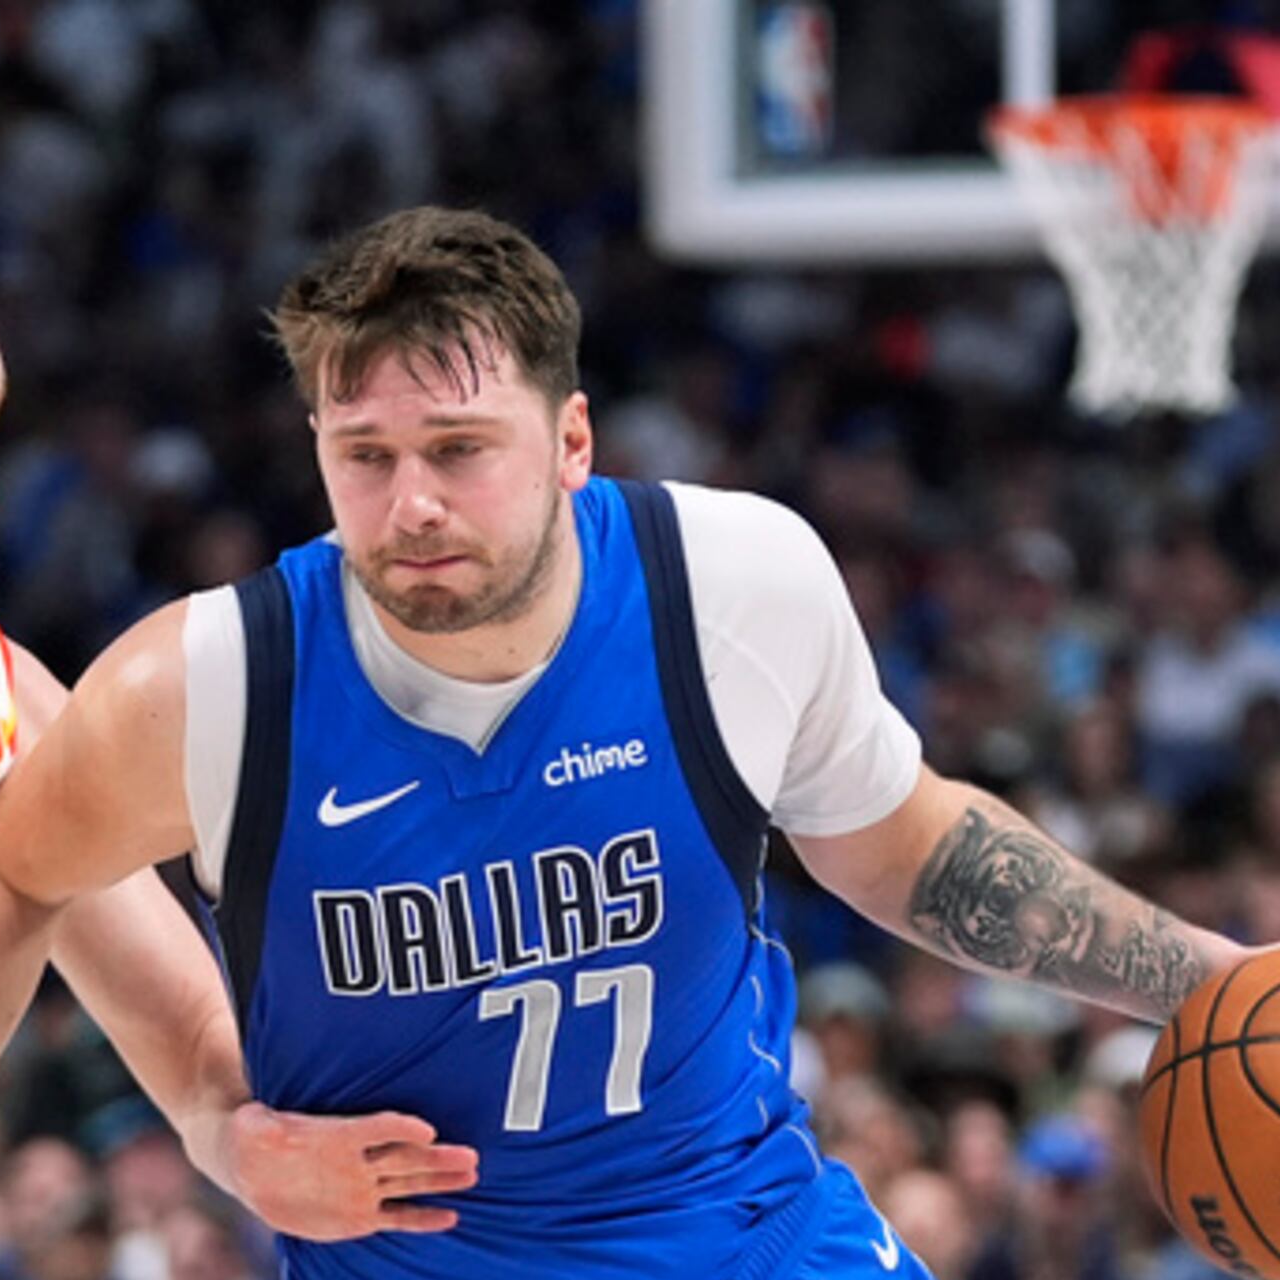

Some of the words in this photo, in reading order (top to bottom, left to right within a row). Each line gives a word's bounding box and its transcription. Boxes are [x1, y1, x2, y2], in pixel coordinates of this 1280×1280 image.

[543, 738, 648, 787] chime
[312, 827, 664, 997] DALLAS
[477, 963, 654, 1132] 77
